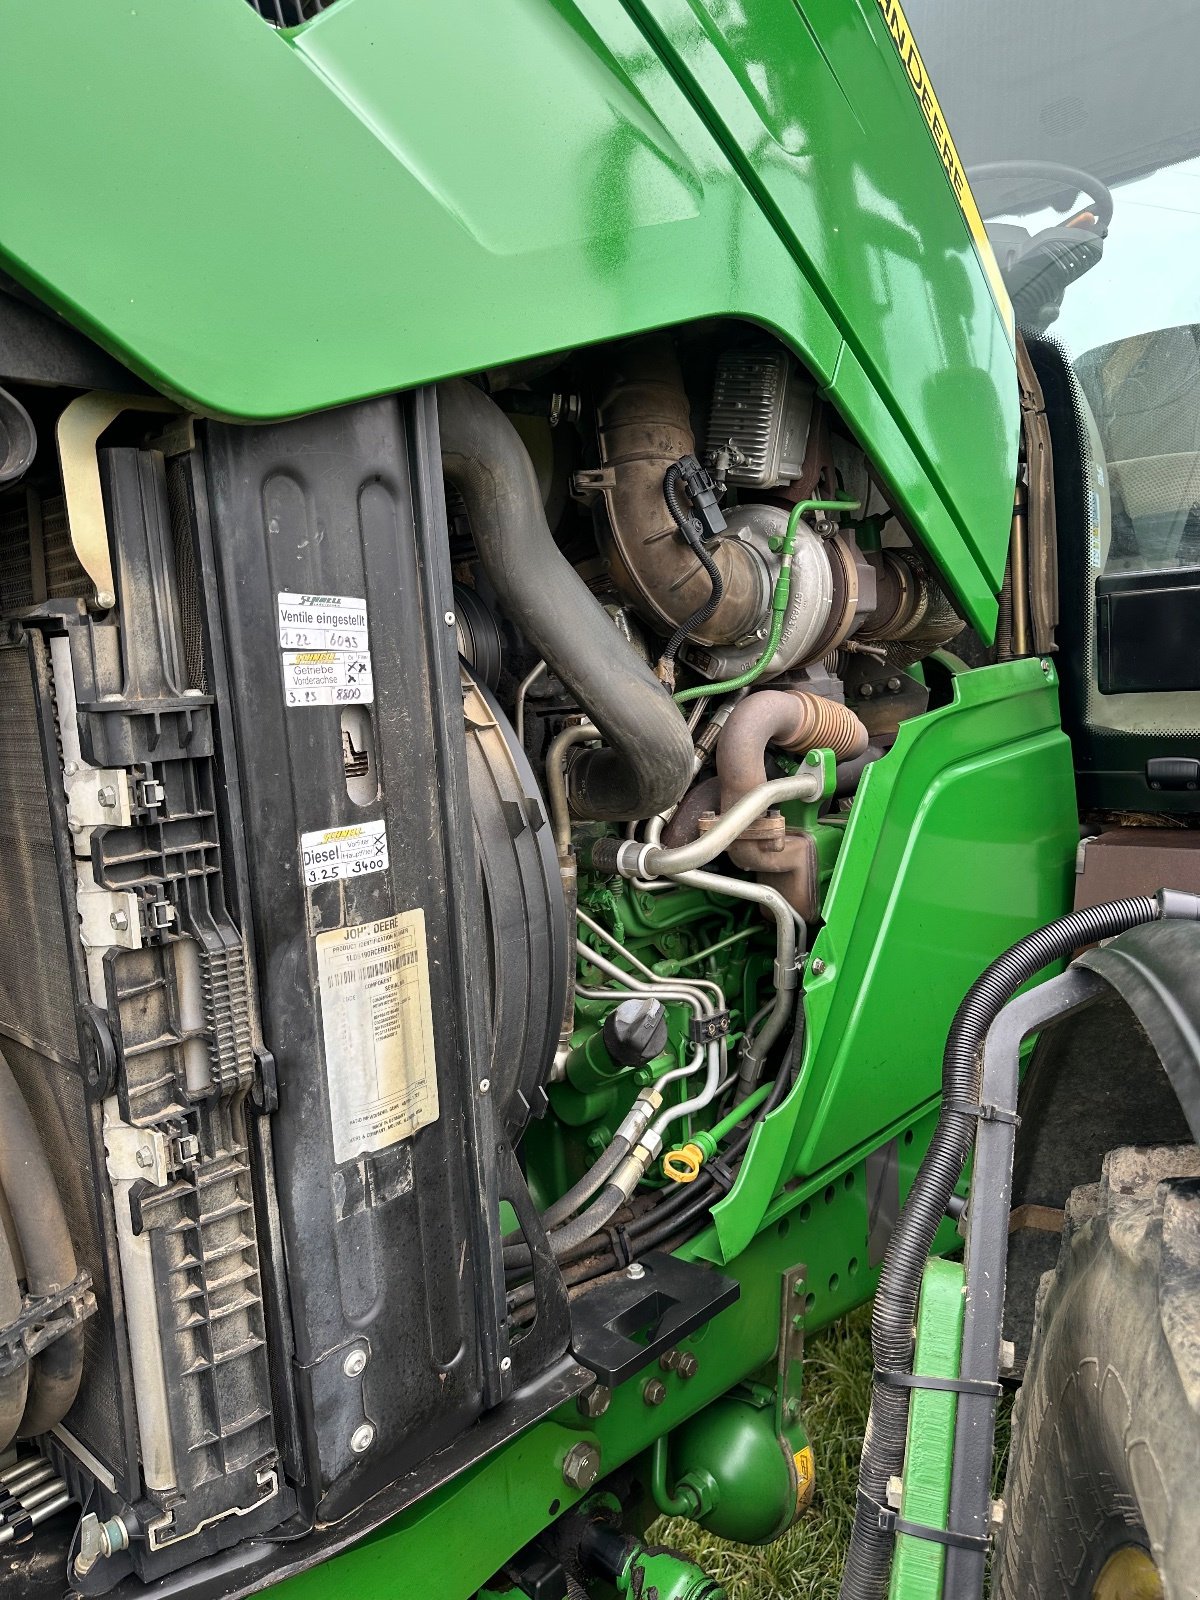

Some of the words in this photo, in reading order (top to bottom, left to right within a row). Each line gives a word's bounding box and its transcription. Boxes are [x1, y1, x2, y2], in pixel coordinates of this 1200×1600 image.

[280, 610, 313, 623] Ventile
[316, 612, 365, 627] eingestellt
[294, 665, 334, 675] Getriebe
[292, 676, 338, 685] Vorderachse
[303, 845, 339, 866] Diesel
[373, 918, 399, 934] DEERE
